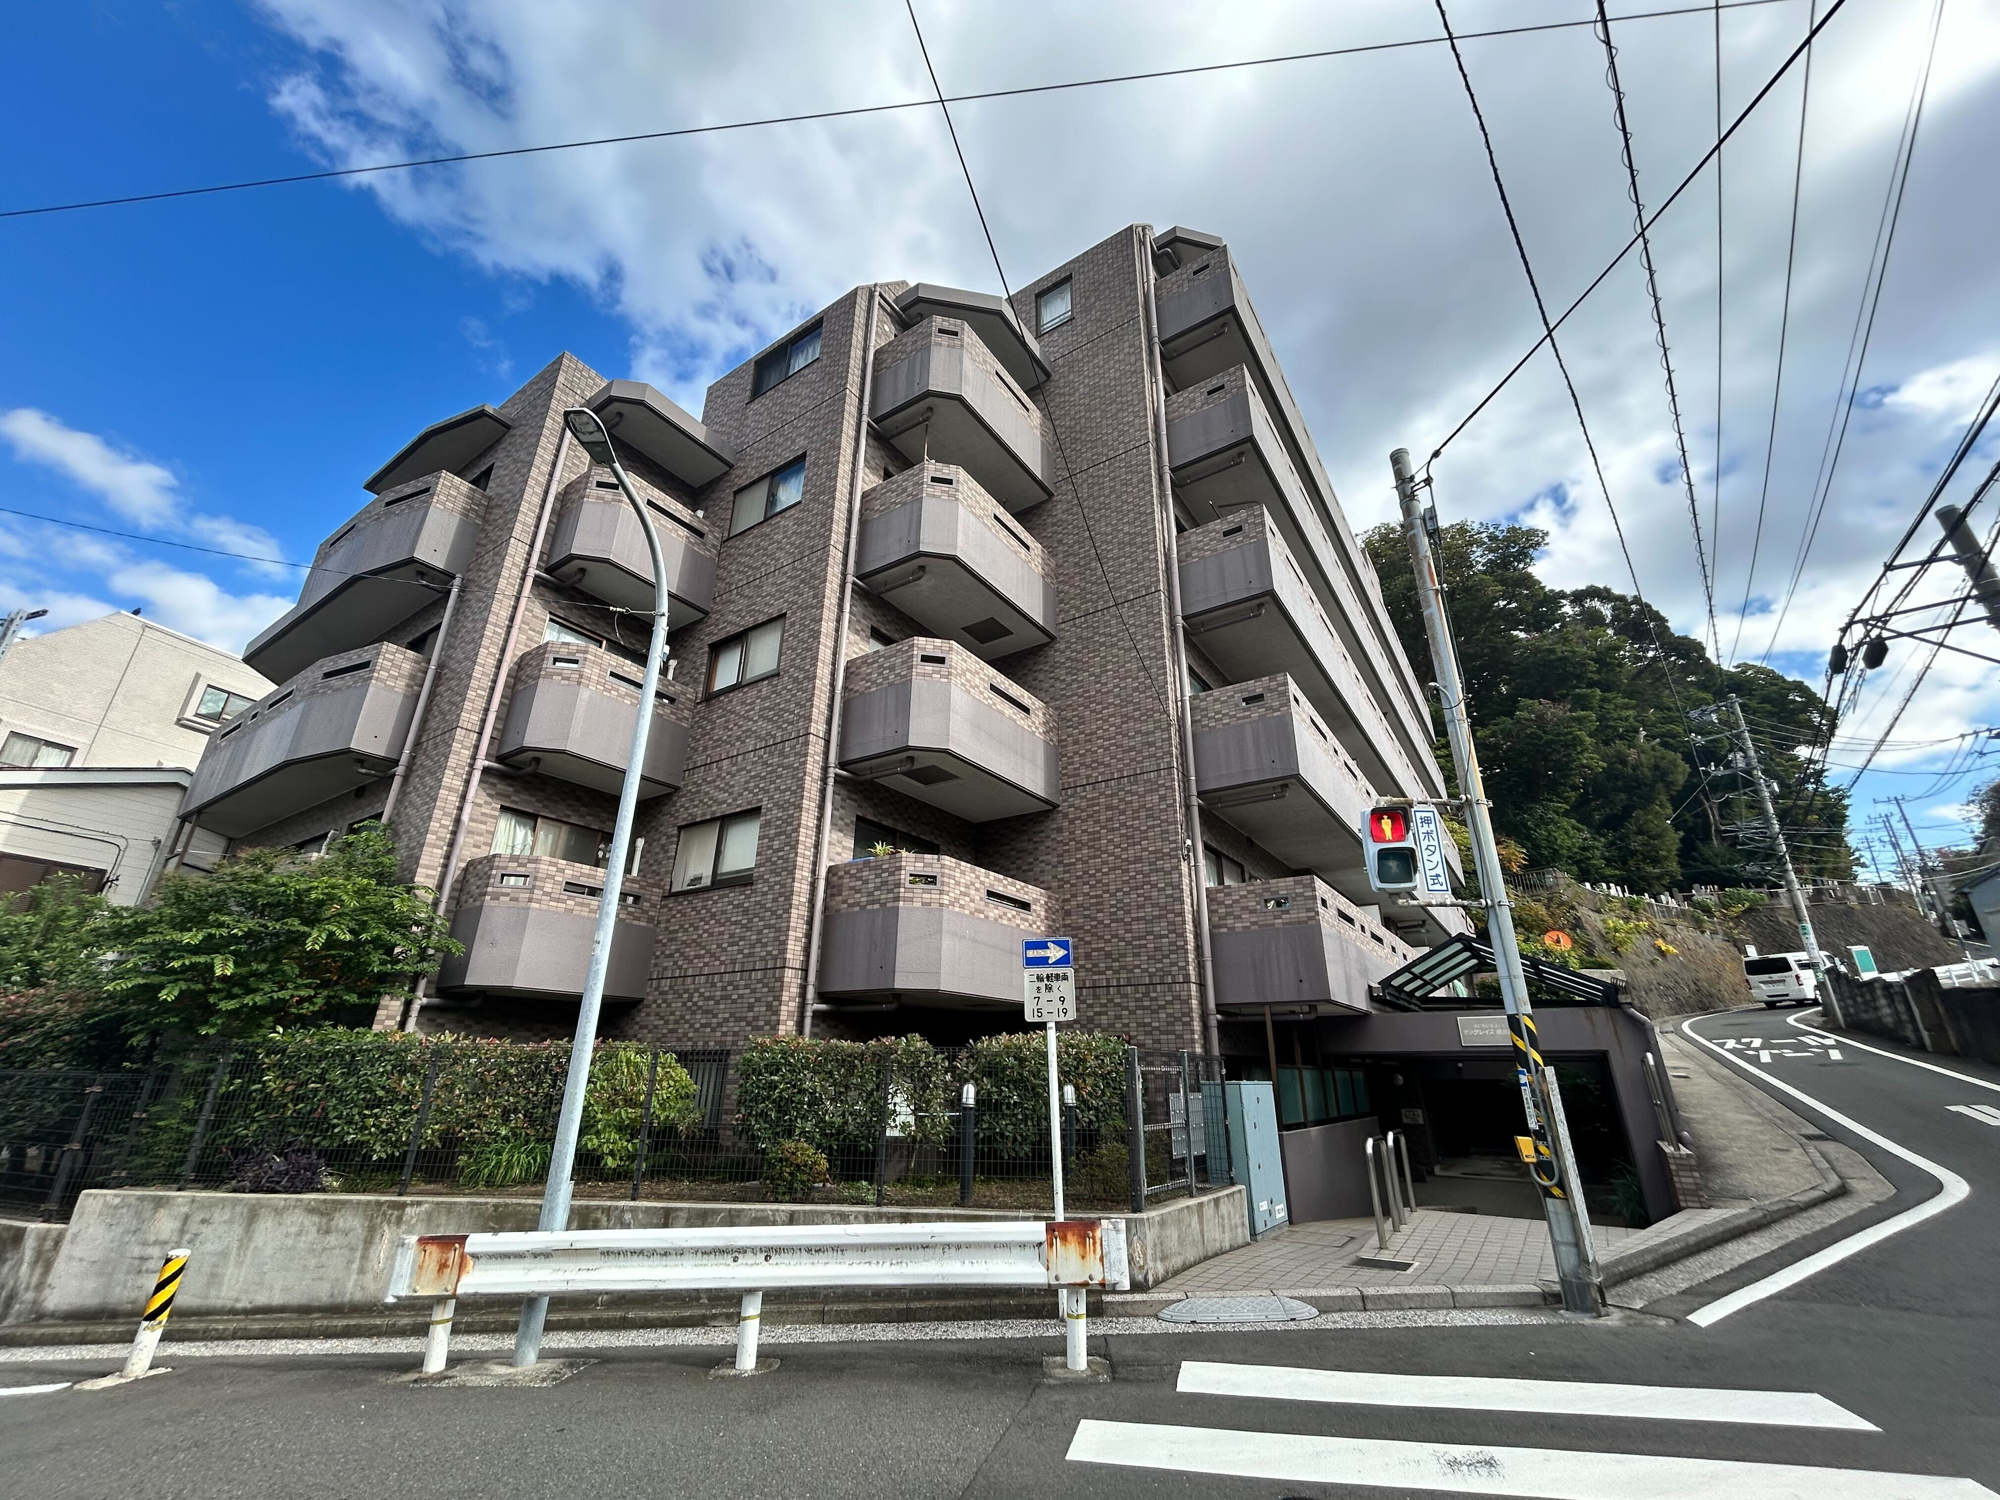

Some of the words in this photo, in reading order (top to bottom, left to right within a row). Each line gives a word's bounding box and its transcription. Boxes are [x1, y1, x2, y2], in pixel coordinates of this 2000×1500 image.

[1418, 815, 1444, 887] 押ボタン式
[1035, 983, 1062, 993] を除く
[1711, 1035, 1837, 1049] スクール
[1743, 1048, 1843, 1063] ゾーン
